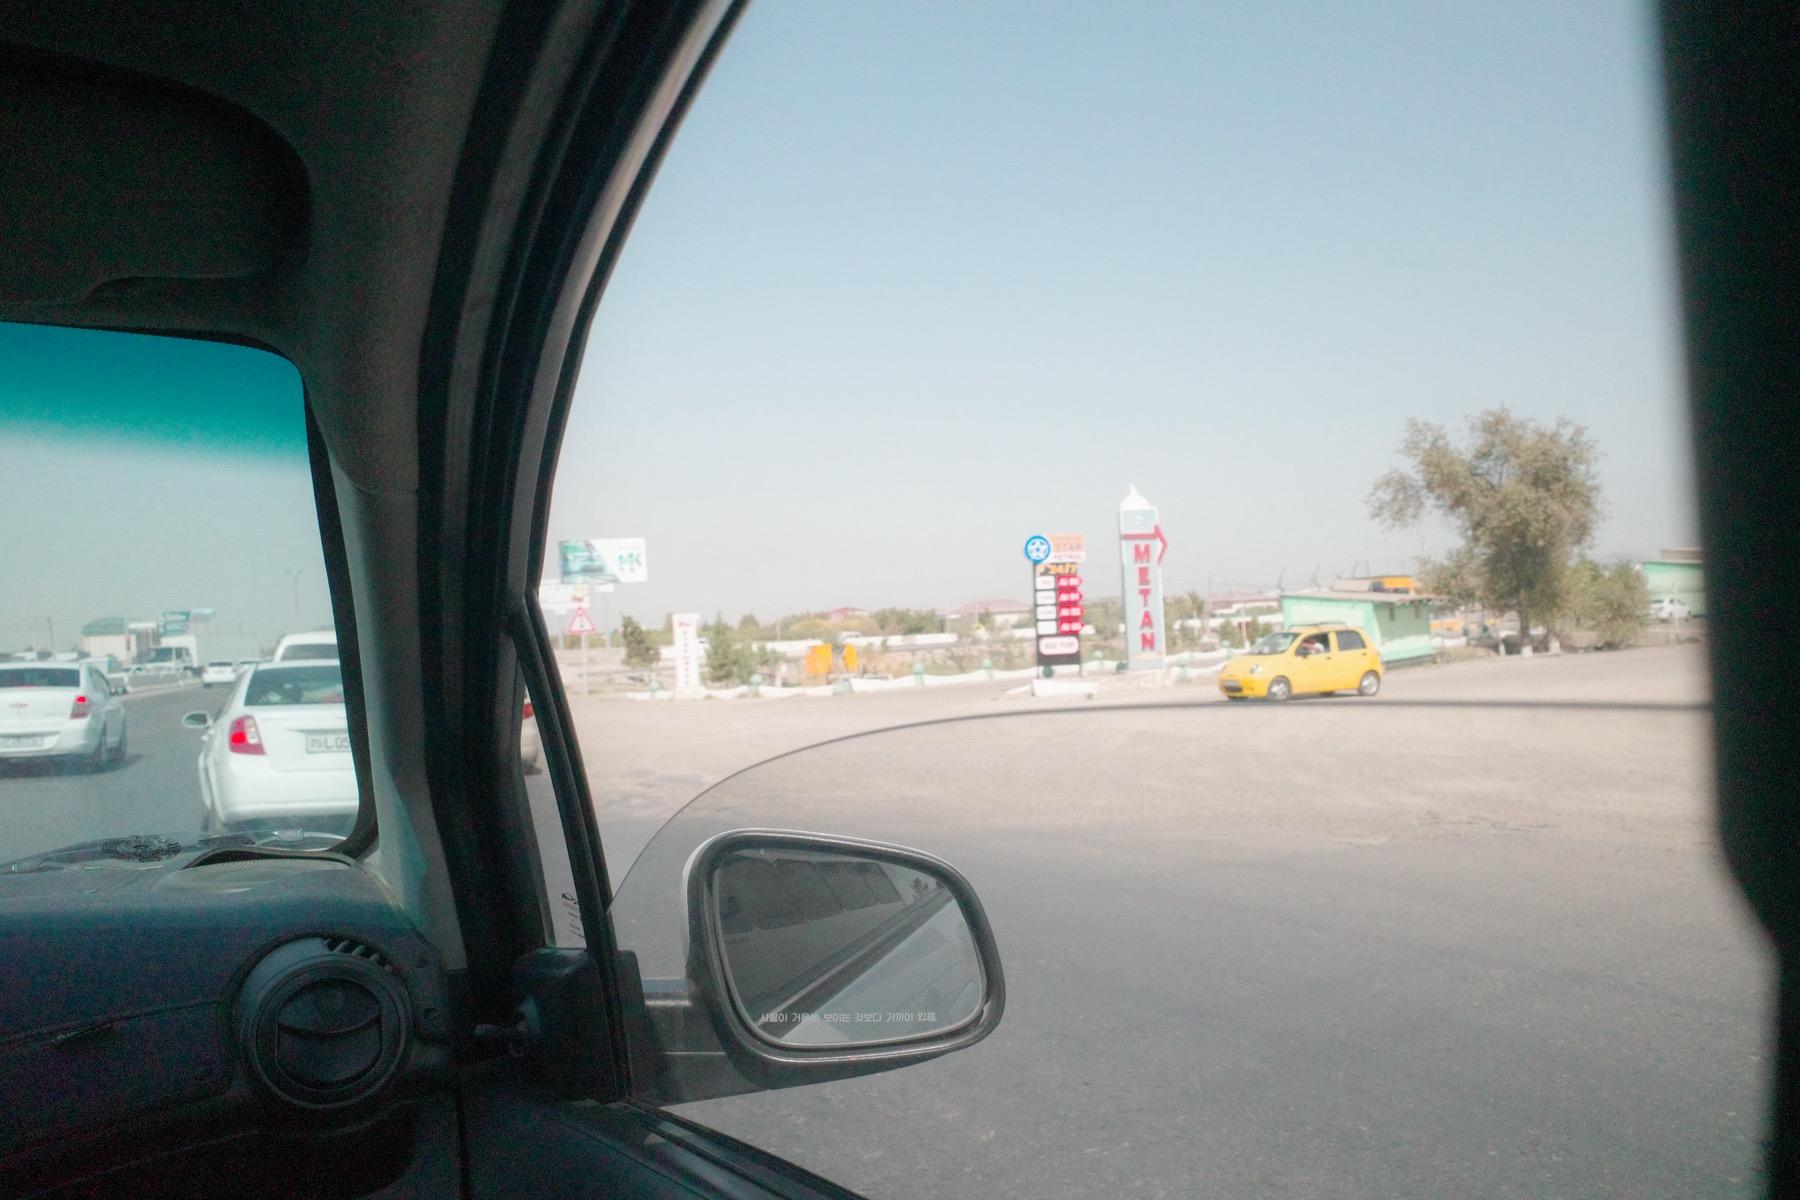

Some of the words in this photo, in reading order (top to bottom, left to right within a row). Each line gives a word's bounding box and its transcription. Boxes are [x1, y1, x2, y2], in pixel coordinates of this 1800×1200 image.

[1133, 543, 1156, 652] METAN
[760, 1012, 787, 1023] 사물이
[823, 1012, 851, 1023] 보이는
[855, 1012, 882, 1023] 것보다
[917, 1011, 936, 1022] 있음
